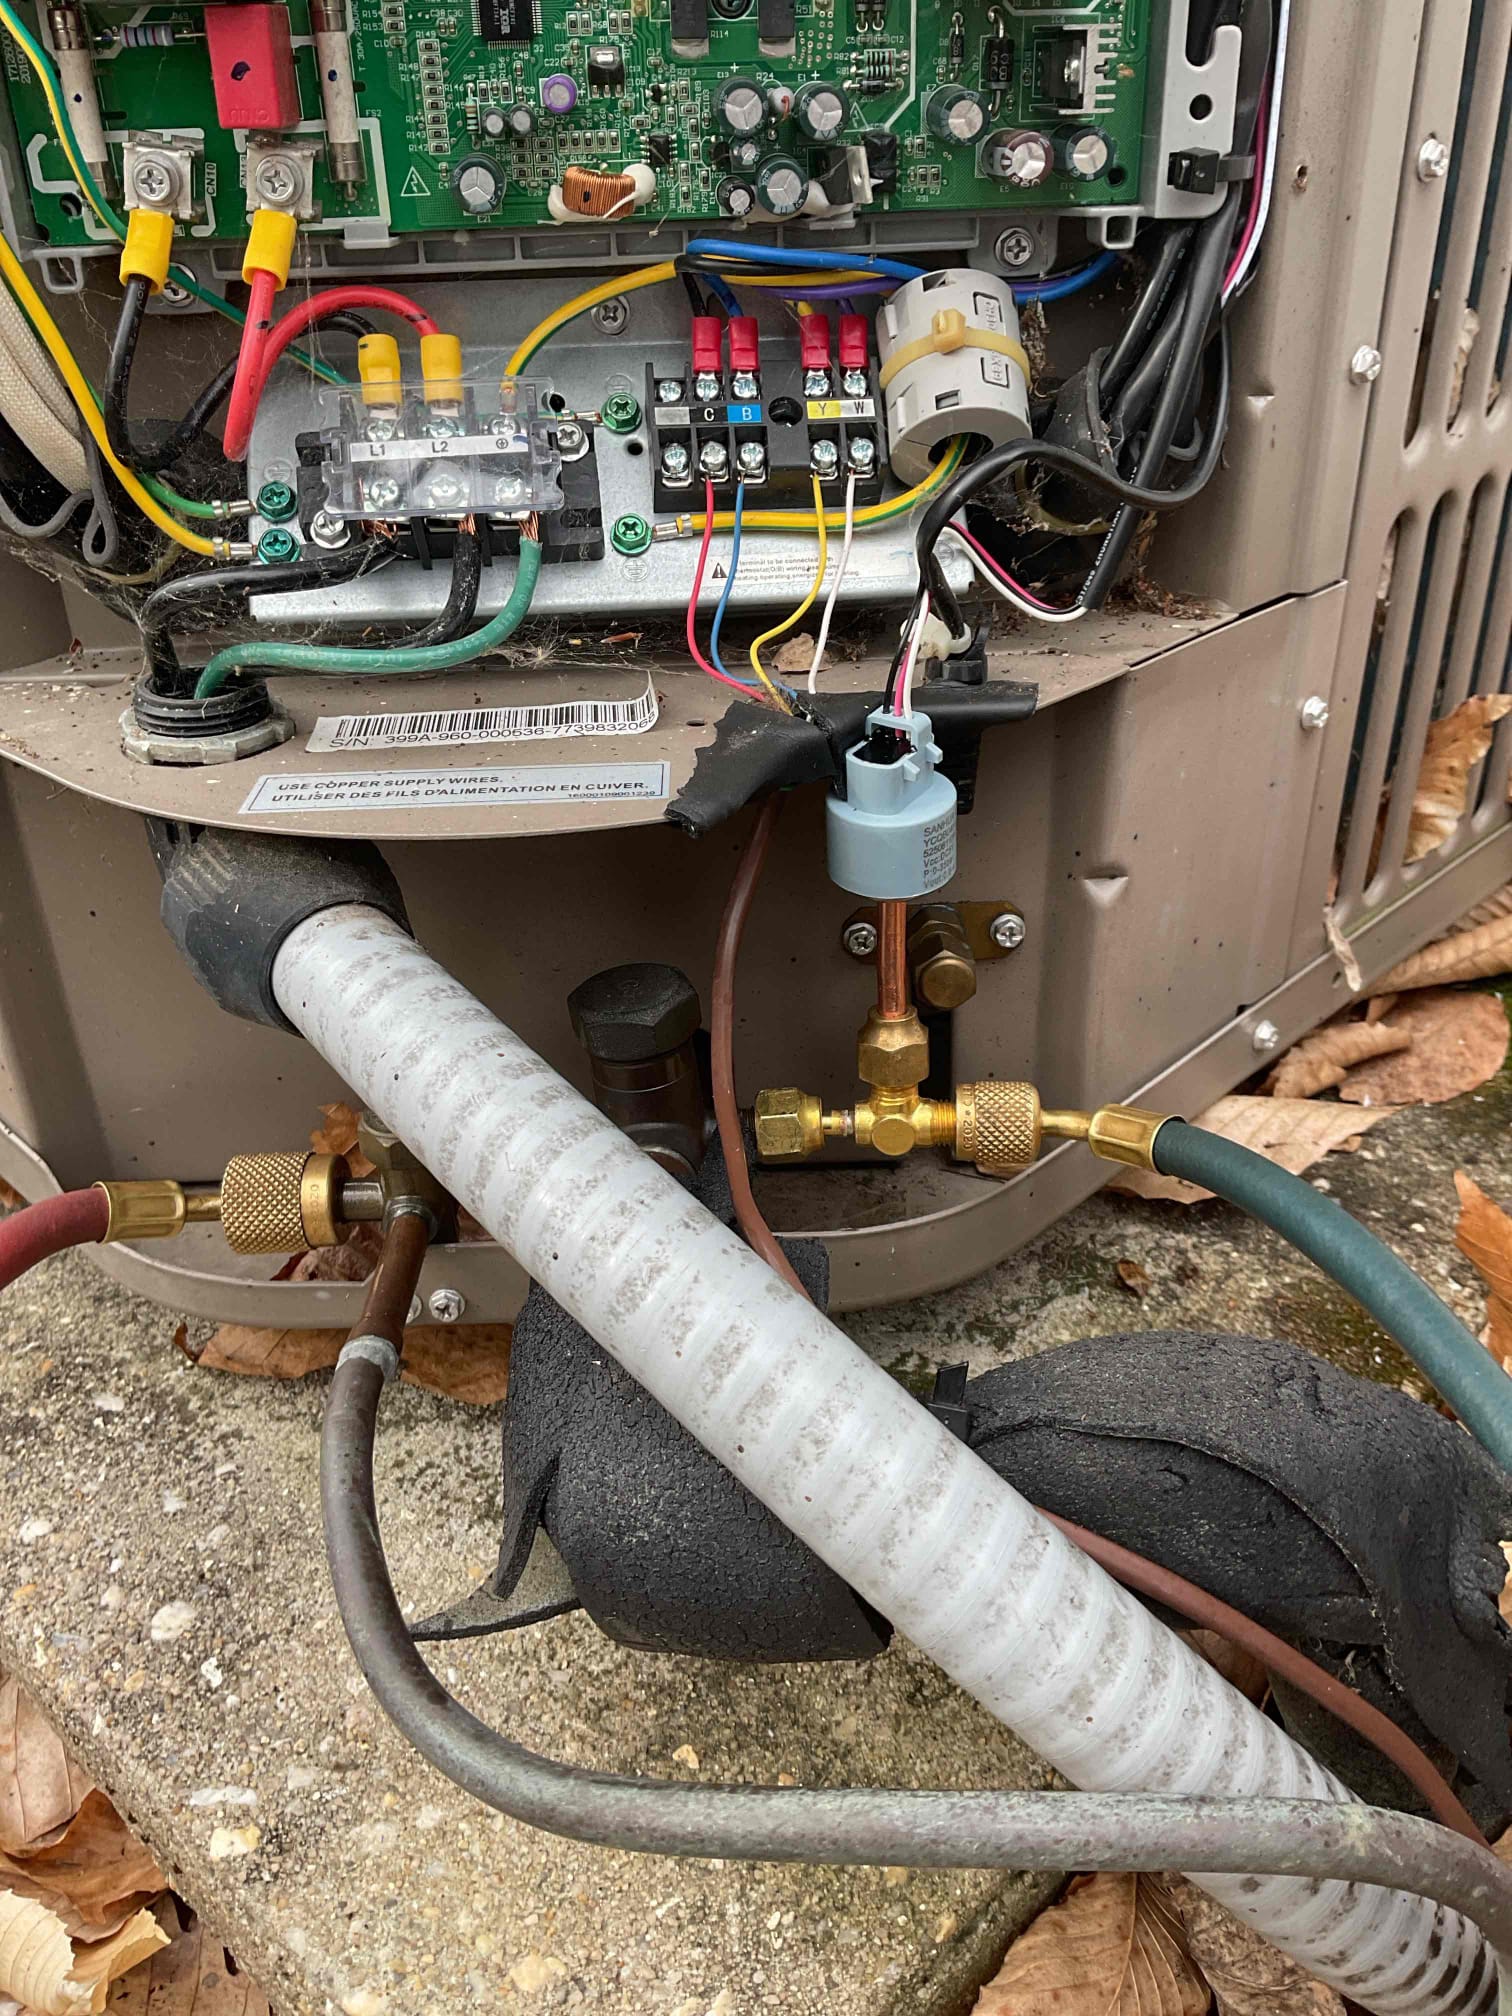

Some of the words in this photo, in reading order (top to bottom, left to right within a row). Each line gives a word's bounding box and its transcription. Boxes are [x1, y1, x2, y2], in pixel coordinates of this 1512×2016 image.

[207, 163, 217, 195] CN10
[703, 408, 715, 422] C
[742, 408, 752, 421] B
[818, 402, 827, 415] Y
[853, 401, 865, 413] W
[370, 444, 386, 457] L1
[431, 441, 449, 453] L2
[329, 737, 373, 748] S/N:
[272, 792, 345, 801] UTILISER
[349, 790, 381, 799] DES
[386, 788, 421, 798] FILS
[424, 784, 556, 796] D'ALIMENTATION
[560, 784, 581, 792] EN
[585, 782, 648, 791] CUIVER.
[279, 783, 311, 791] USE
[314, 780, 380, 790] COPPER
[383, 777, 447, 787] SUPPLY
[448, 776, 503, 785] WIRES.
